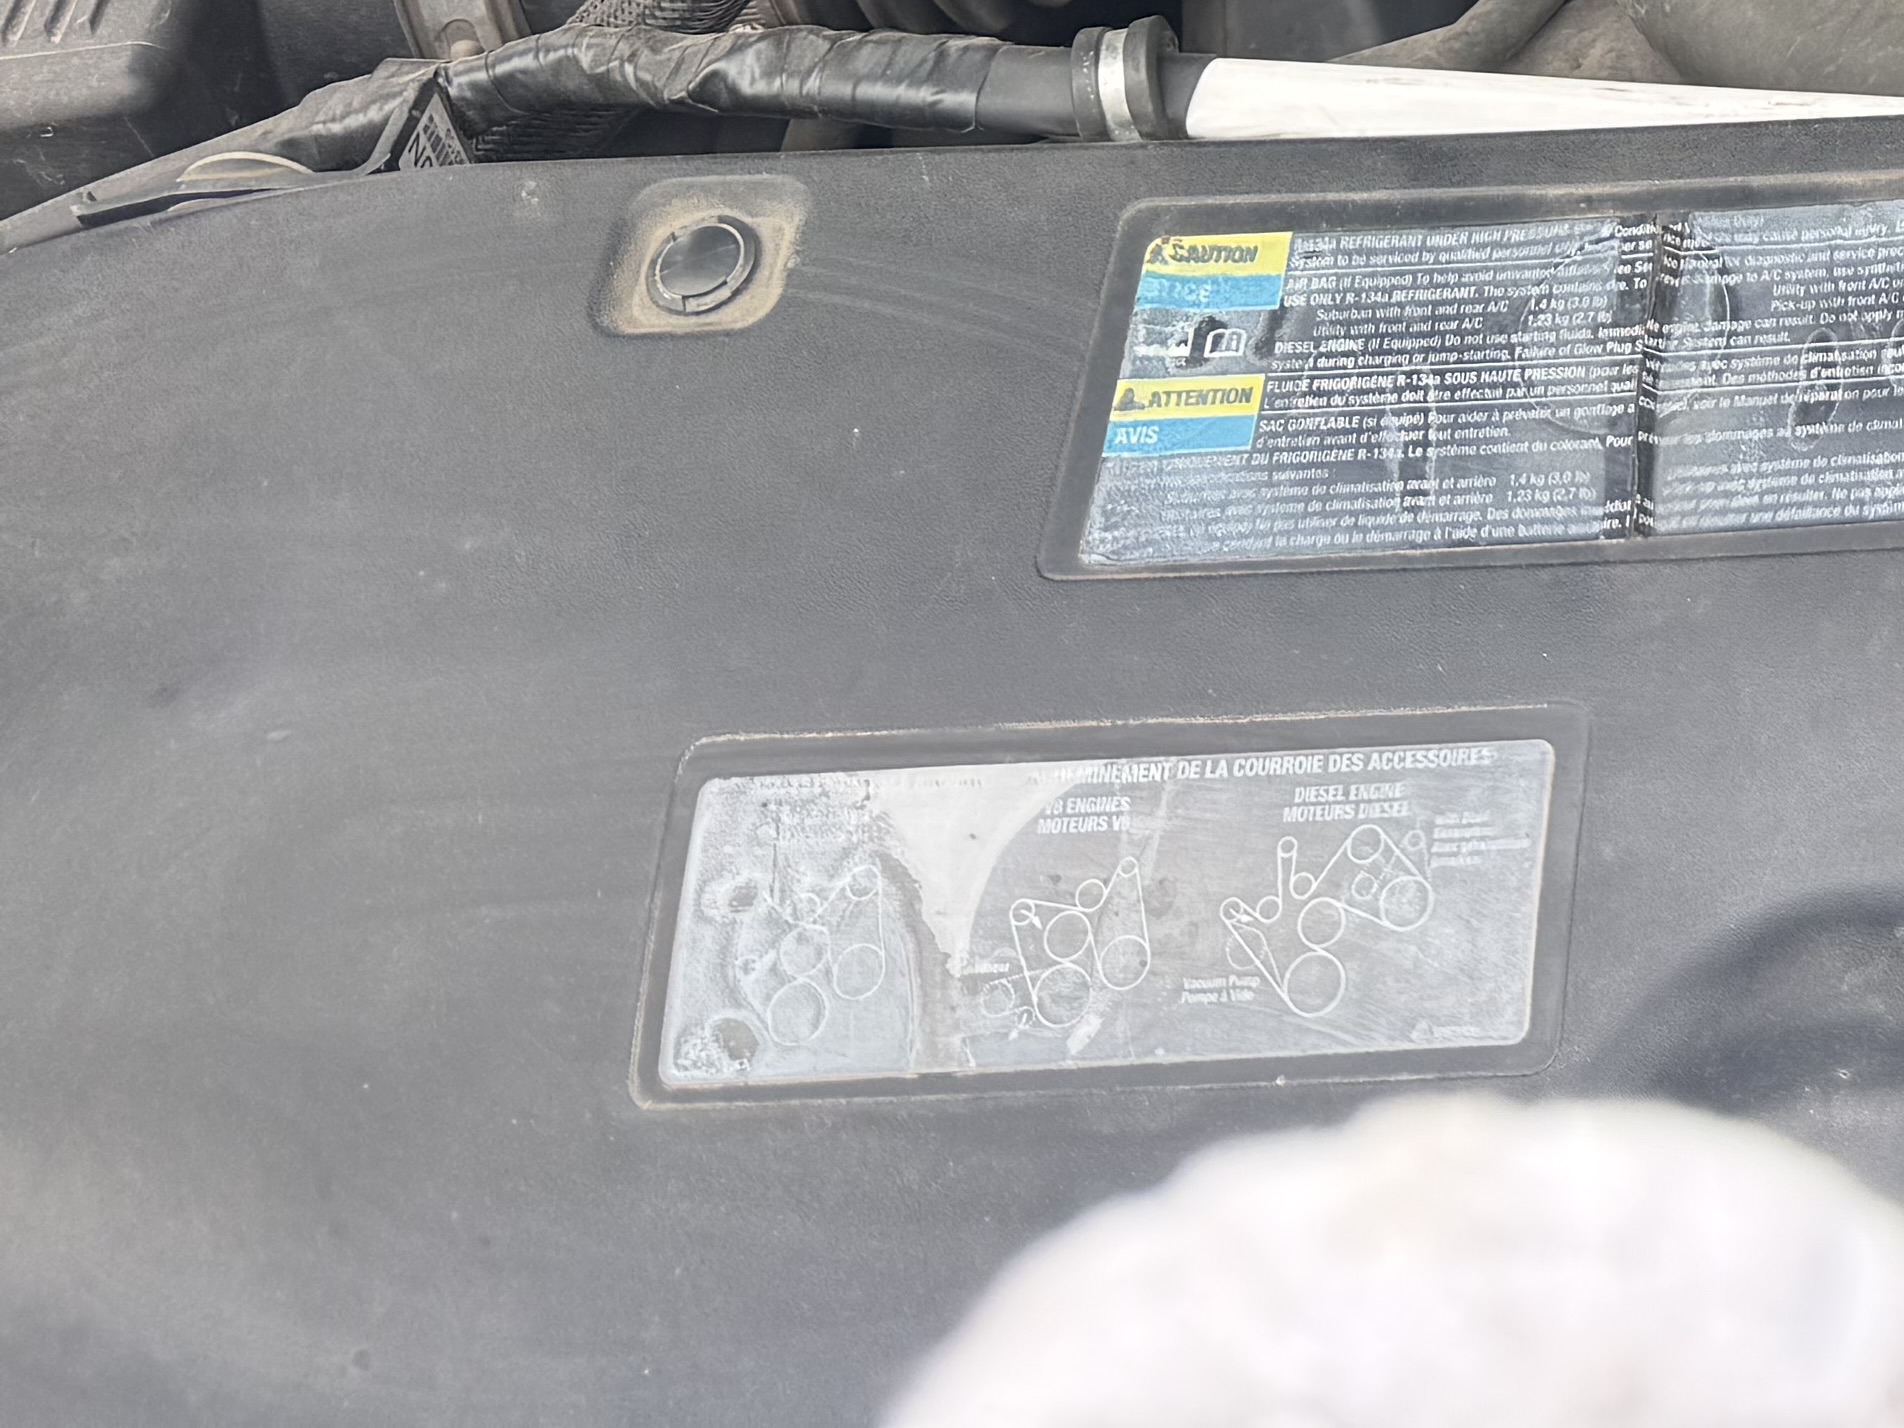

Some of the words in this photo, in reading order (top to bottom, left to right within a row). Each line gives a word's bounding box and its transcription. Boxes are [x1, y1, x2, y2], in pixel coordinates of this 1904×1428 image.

[1340, 234, 1423, 250] REFRIGERANT
[1426, 231, 1468, 247] UNDER
[1471, 230, 1502, 245] HIGH
[1169, 243, 1259, 264] CAUTION
[1338, 253, 1349, 265] to
[1369, 249, 1419, 265] serviced
[1423, 248, 1436, 263] by
[1439, 243, 1491, 262] qualified
[1286, 277, 1309, 291] AIR
[1311, 276, 1338, 291] BAG
[1355, 271, 1413, 290] Equipped)
[1416, 272, 1430, 286] To
[1433, 268, 1459, 287] help
[1869, 275, 1891, 290] A/C
[1284, 293, 1308, 308] USE
[1310, 292, 1344, 306] ONLY
[1483, 282, 1506, 299] The
[1316, 306, 1372, 322] Suburban
[1375, 304, 1401, 320] with
[1404, 303, 1432, 318] front
[1434, 301, 1458, 316] and
[1487, 299, 1510, 313] A/C
[1379, 319, 1407, 334] front
[1410, 318, 1433, 333] and
[1462, 316, 1484, 330] A/C
[1755, 318, 1777, 331] can
[1275, 340, 1316, 355] DIESEL
[1383, 333, 1442, 352] Equipped)
[1446, 333, 1461, 347] Do
[1464, 332, 1484, 346] not
[1317, 351, 1356, 370] during
[1359, 349, 1410, 368] charging
[1413, 350, 1427, 363] or
[1559, 342, 1572, 356] of
[1606, 339, 1633, 355] Plug
[1444, 369, 1478, 386] SOUS
[1481, 367, 1522, 384] HAUTE
[1524, 364, 1587, 381] PRESSION
[1148, 386, 1255, 408] ATTENTION
[1400, 387, 1425, 402] doit
[1259, 418, 1285, 434] SAC
[1287, 414, 1361, 432] GONFLABLE
[1114, 425, 1160, 445] AVIS
[1251, 452, 1270, 466] DU
[1408, 444, 1425, 458] Le
[1605, 433, 1634, 449] Pour
[1175, 760, 1202, 782] DE
[1204, 759, 1229, 781] LA
[1232, 755, 1325, 779] COURROIE
[1327, 752, 1366, 776] DES
[1368, 747, 1497, 773] ACCESSOIRES
[1293, 784, 1348, 804] DIESEL
[1350, 782, 1407, 802] ENGINE
[1066, 795, 1132, 814] ENGINES
[1283, 803, 1356, 824] MOTEURS
[1037, 815, 1109, 835] MOTEURS
